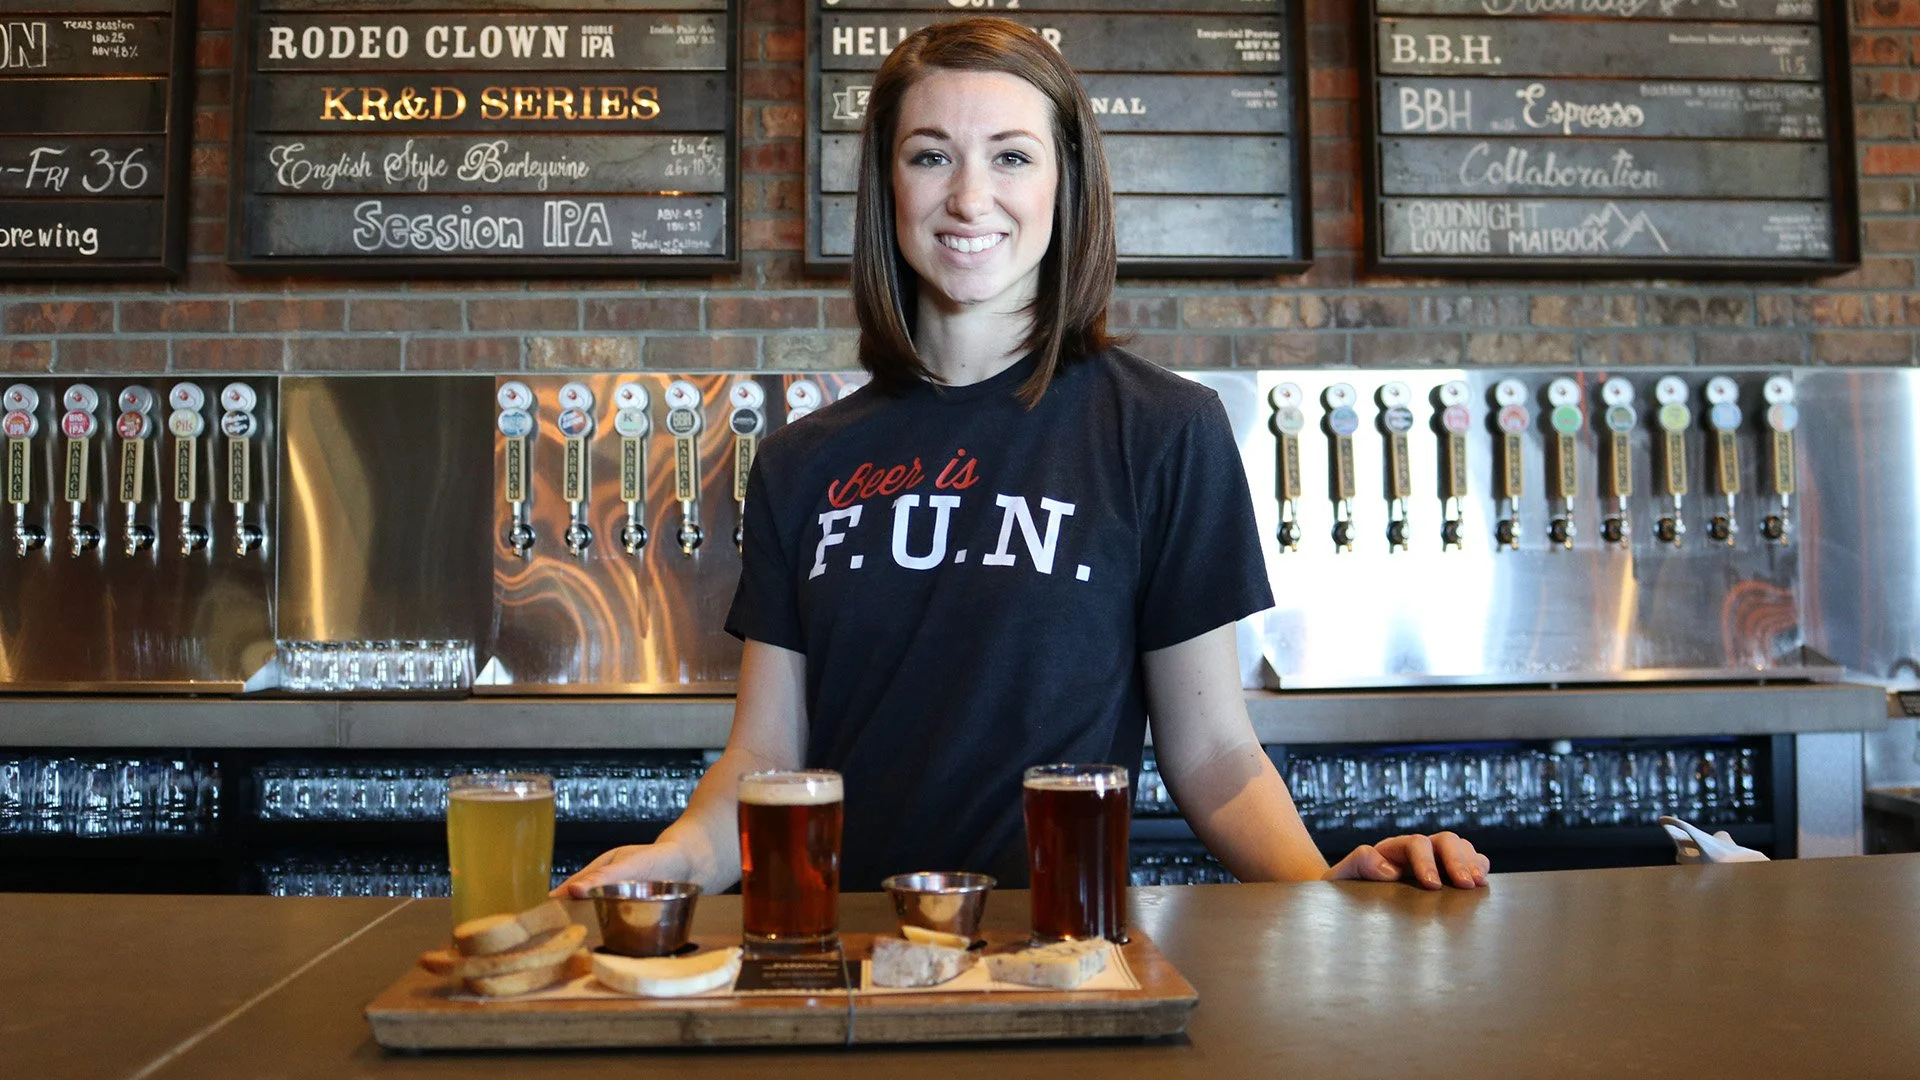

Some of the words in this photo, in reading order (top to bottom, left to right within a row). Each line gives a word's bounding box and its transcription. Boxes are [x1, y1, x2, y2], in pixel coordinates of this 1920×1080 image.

[0, 22, 47, 69] N
[268, 25, 409, 59] RODEO
[425, 25, 569, 58] CLOWN
[581, 35, 615, 58] IPA
[1391, 34, 1501, 64] B.B.H.
[319, 86, 467, 121] KR&D
[480, 85, 661, 121] SERIES
[1090, 97, 1146, 114] NAL
[1399, 86, 1472, 132] BBH
[1515, 83, 1645, 135] Espresso
[82, 148, 148, 193] 3-6
[269, 143, 373, 190] English
[383, 139, 448, 191] Style
[457, 140, 590, 191] Barleywine
[1459, 142, 1659, 189] Collaboration
[352, 200, 524, 251] Session
[543, 200, 613, 248] IPA
[1408, 201, 1546, 230] GOODNIGHT
[1411, 229, 1490, 252] LOVING
[1508, 228, 1609, 253] MAIBOCK
[828, 457, 925, 507] Beer
[935, 448, 979, 489] is
